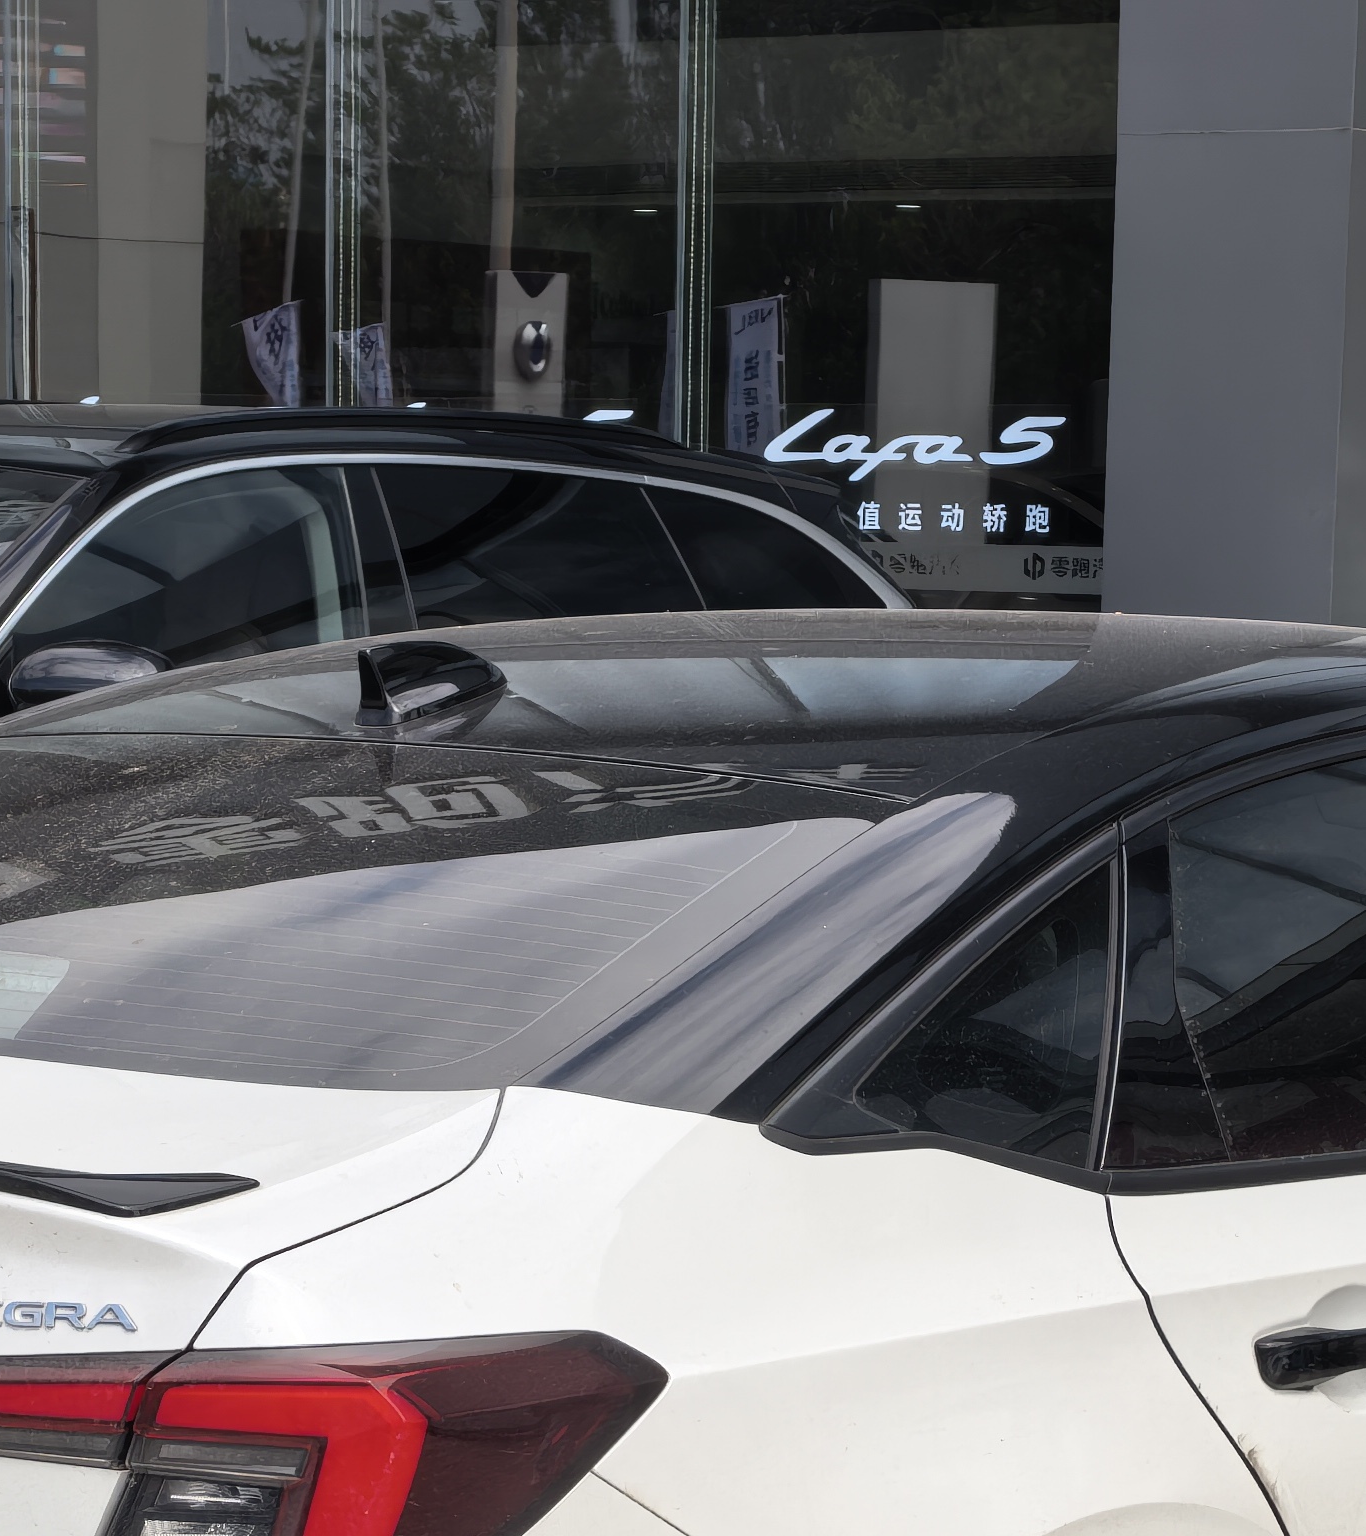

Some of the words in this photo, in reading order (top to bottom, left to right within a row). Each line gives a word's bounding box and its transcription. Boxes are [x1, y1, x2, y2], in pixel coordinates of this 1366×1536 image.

[979, 416, 1067, 465] 5
[856, 500, 1050, 533] 值运动轿跑
